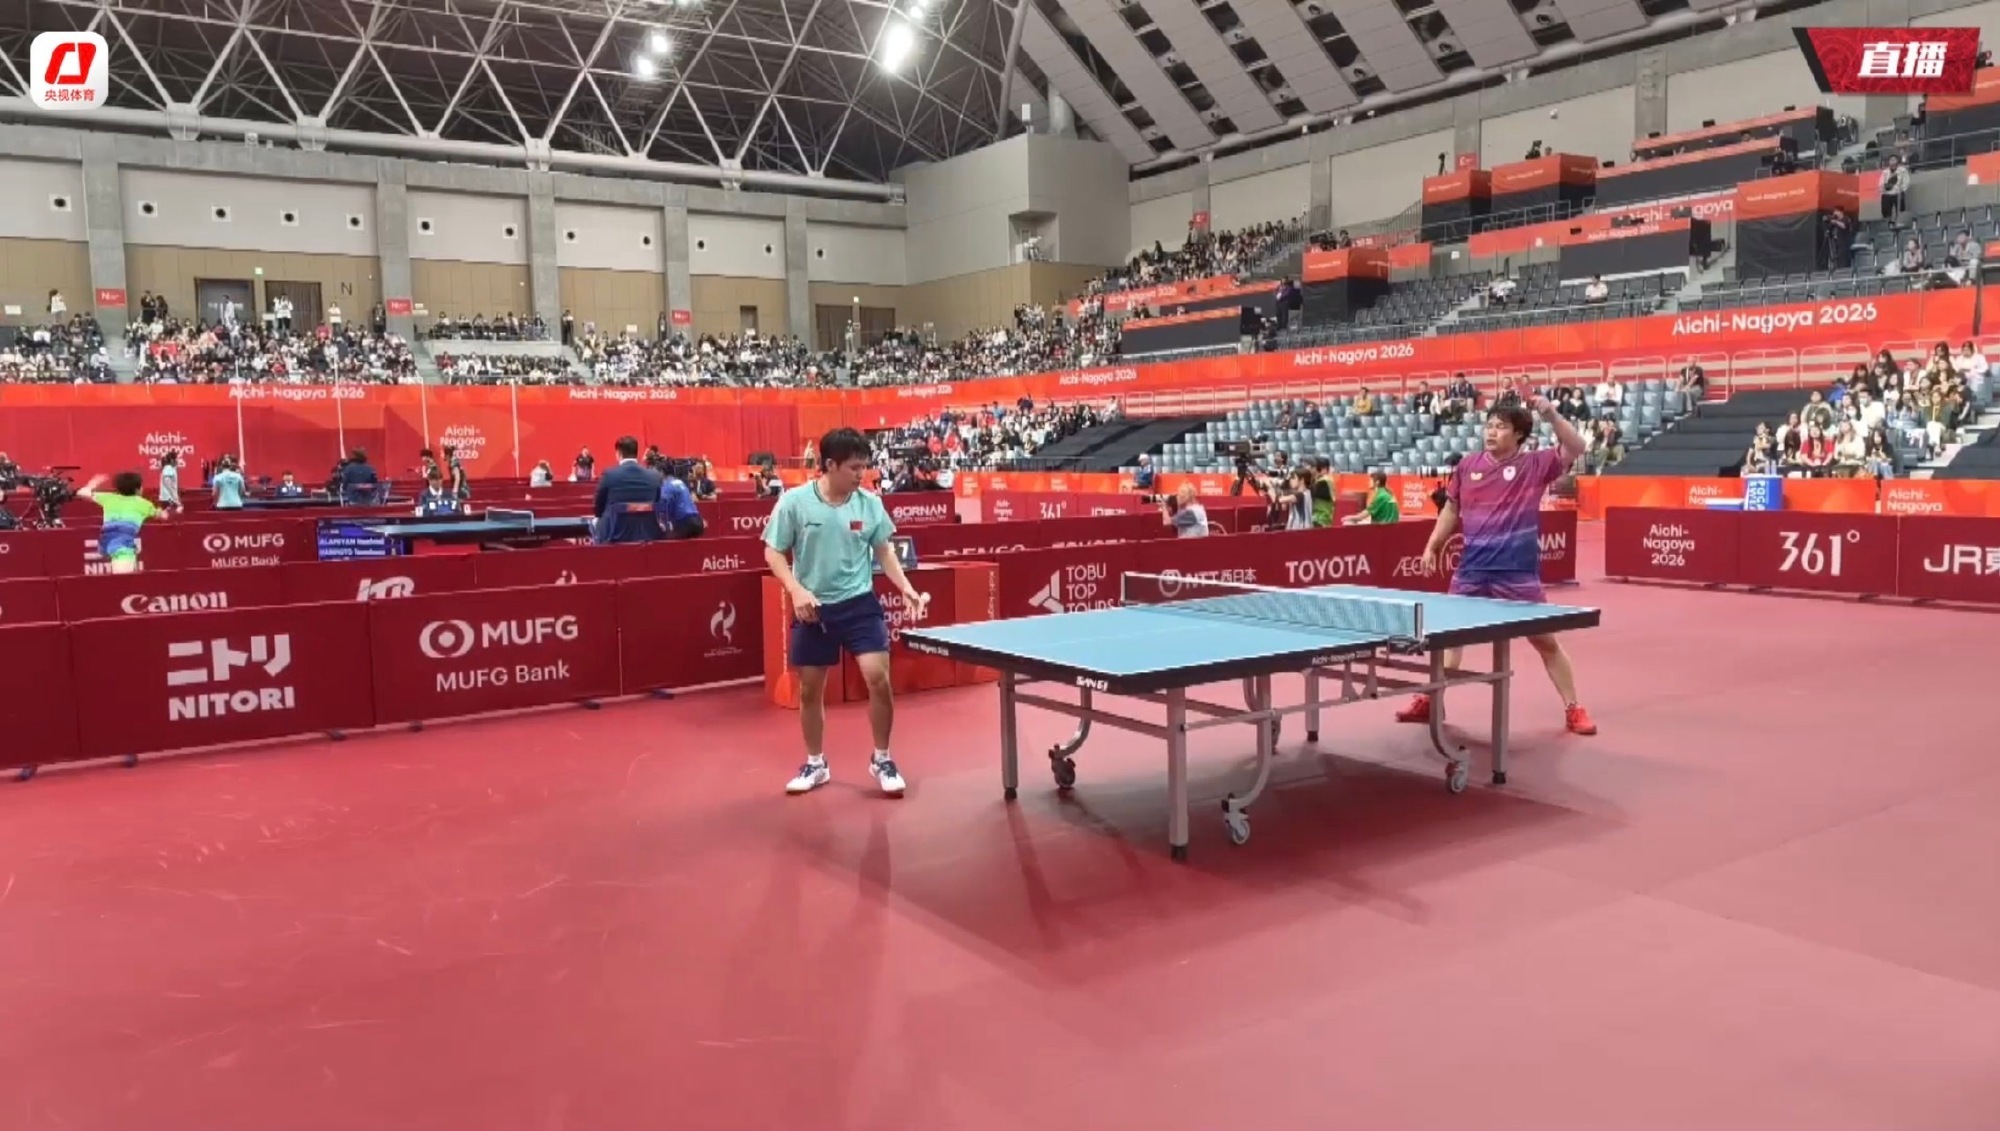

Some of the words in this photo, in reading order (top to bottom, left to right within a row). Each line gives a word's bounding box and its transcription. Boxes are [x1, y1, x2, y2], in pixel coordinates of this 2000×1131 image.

[341, 282, 353, 295] N
[1672, 309, 1813, 336] Aichi-Nagoya
[1819, 302, 1877, 325] 2026
[1294, 348, 1378, 366] Aichi-Nagoya
[1380, 343, 1415, 358] 2026
[229, 386, 327, 401] Aichi-Nagoya
[330, 386, 366, 399] 2026
[569, 388, 647, 402] Aichi-Nagoya
[145, 431, 188, 444] Aichi-
[445, 424, 481, 437] Aichi-
[1689, 484, 1724, 495] Aichi-
[1888, 488, 1931, 500] Aichi-
[1887, 501, 1943, 515] Nagoya
[1652, 524, 1690, 538] Aichi-
[234, 533, 285, 549] MUFG
[1643, 537, 1696, 556] Nagoya
[211, 556, 249, 569] MUFG
[250, 554, 281, 567] Bank
[702, 554, 746, 571] Aichi-
[1651, 552, 1686, 567] 2026
[1066, 562, 1106, 582] TOBU
[1286, 554, 1370, 583] TOYOTA
[1066, 583, 1097, 601] TOP
[121, 591, 228, 615] Canon
[482, 615, 578, 648] MUFG
[167, 634, 291, 686] ニトリ
[436, 667, 508, 692] MUFG
[515, 659, 570, 684] Bank
[168, 686, 296, 722] NITORI
